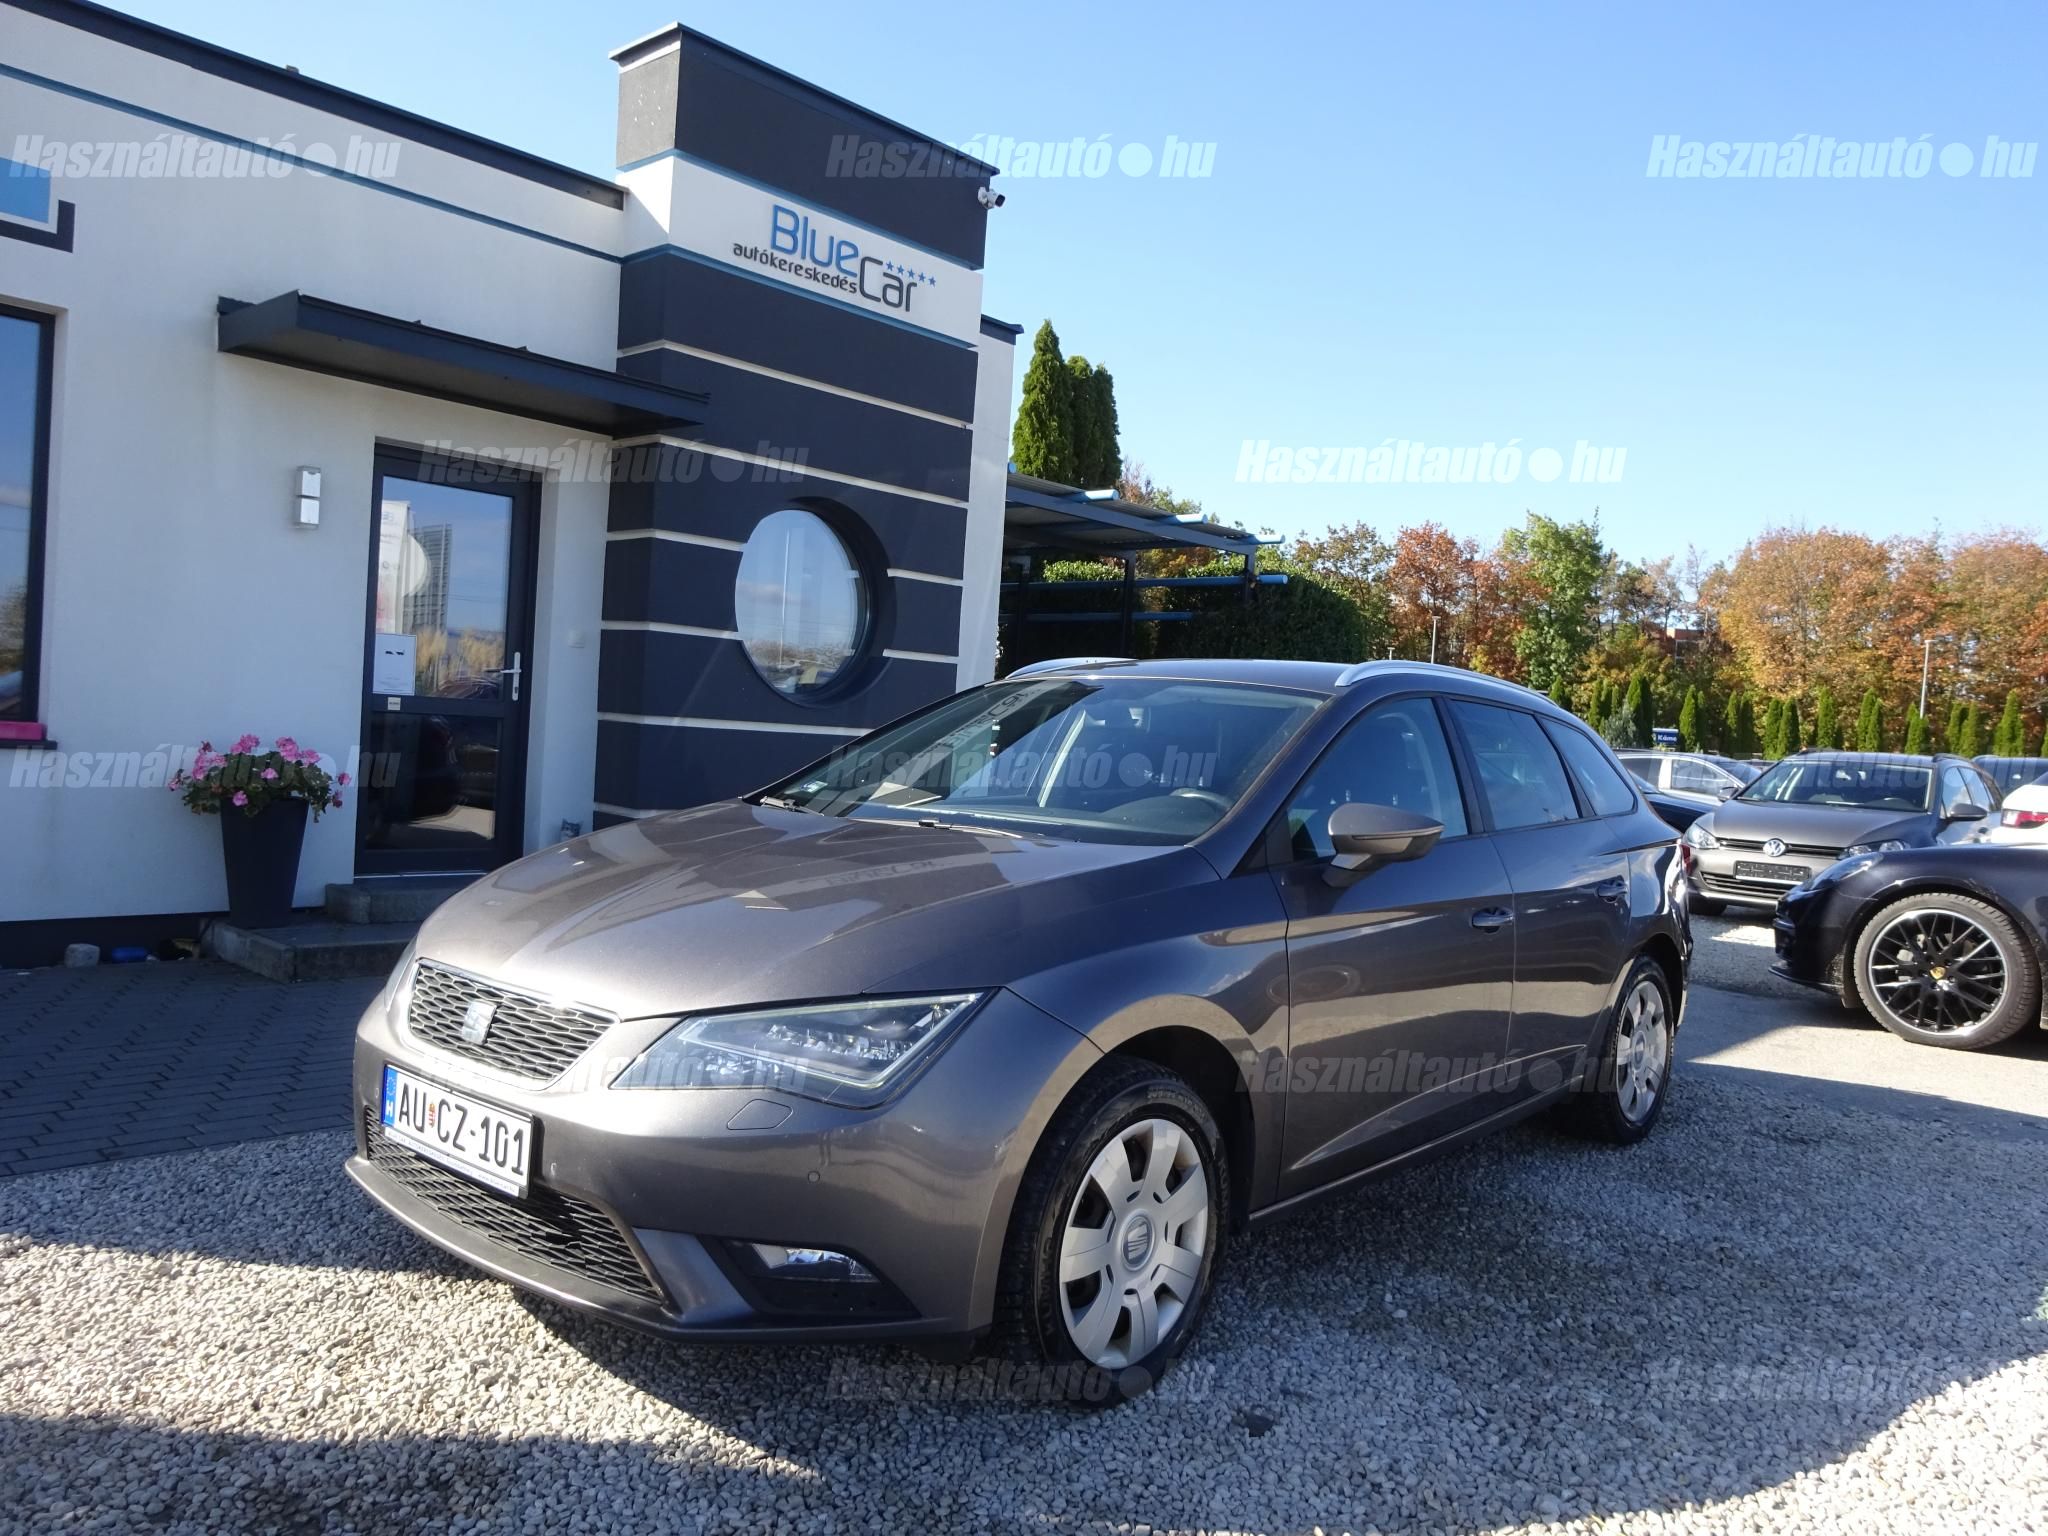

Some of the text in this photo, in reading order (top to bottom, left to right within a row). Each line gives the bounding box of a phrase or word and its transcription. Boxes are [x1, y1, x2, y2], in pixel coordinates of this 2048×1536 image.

[732, 242, 858, 295] autókereskedés
[398, 1082, 524, 1177] AU CZ-101
